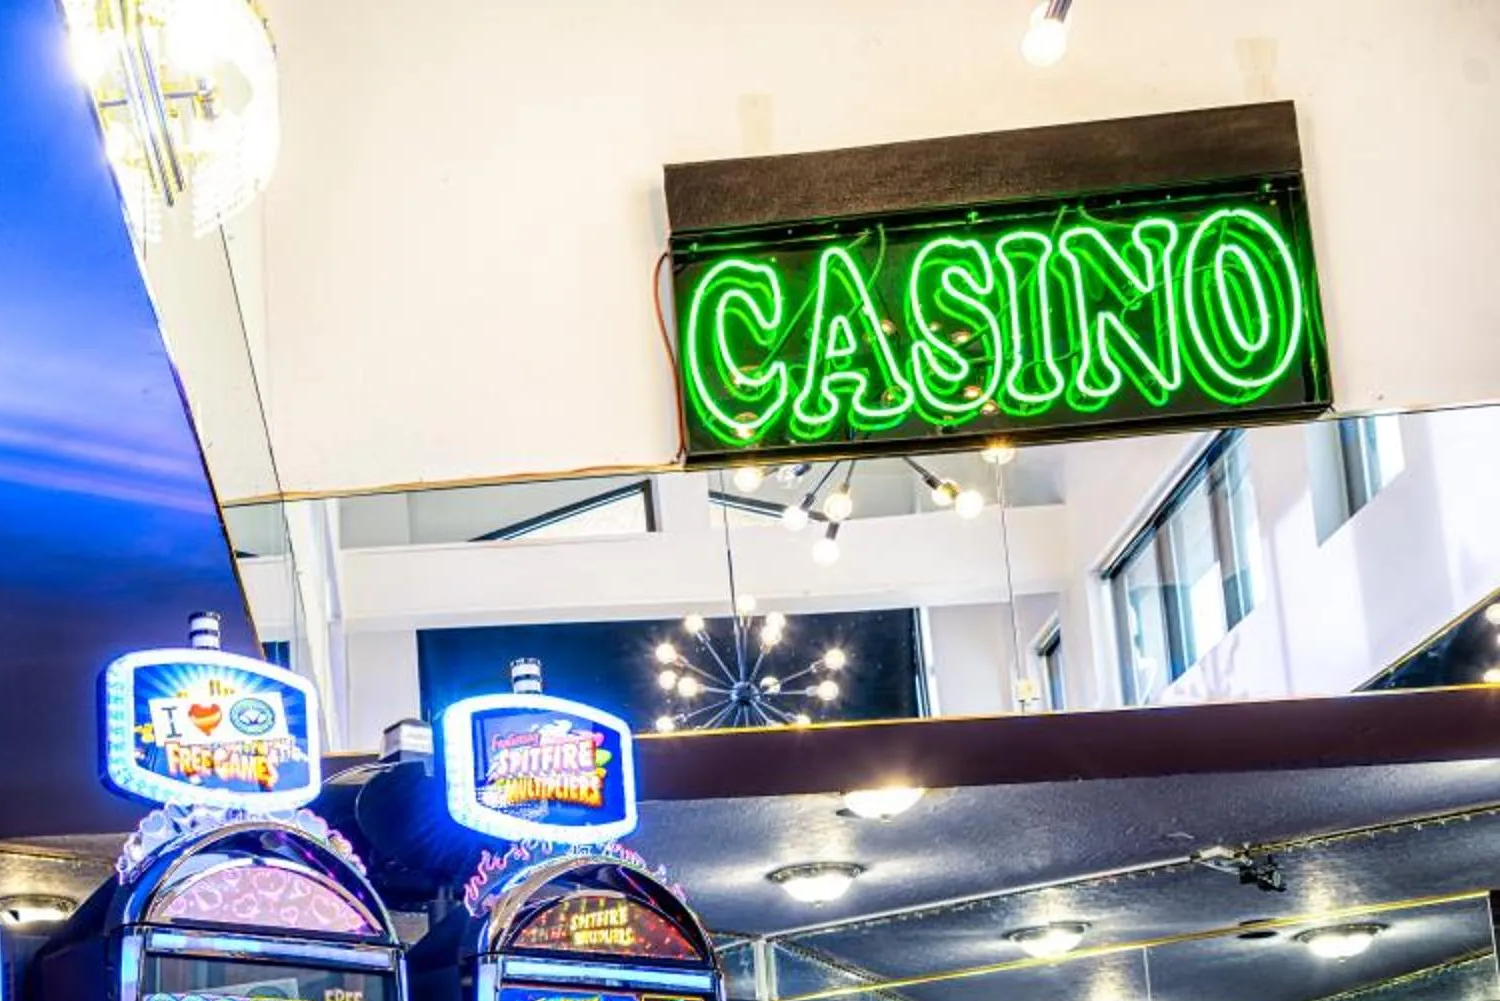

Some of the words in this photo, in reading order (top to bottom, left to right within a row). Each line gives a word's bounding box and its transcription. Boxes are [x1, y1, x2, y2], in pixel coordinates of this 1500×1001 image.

[687, 208, 1303, 444] CASINO
[161, 706, 183, 739] I
[165, 742, 214, 778] FREE
